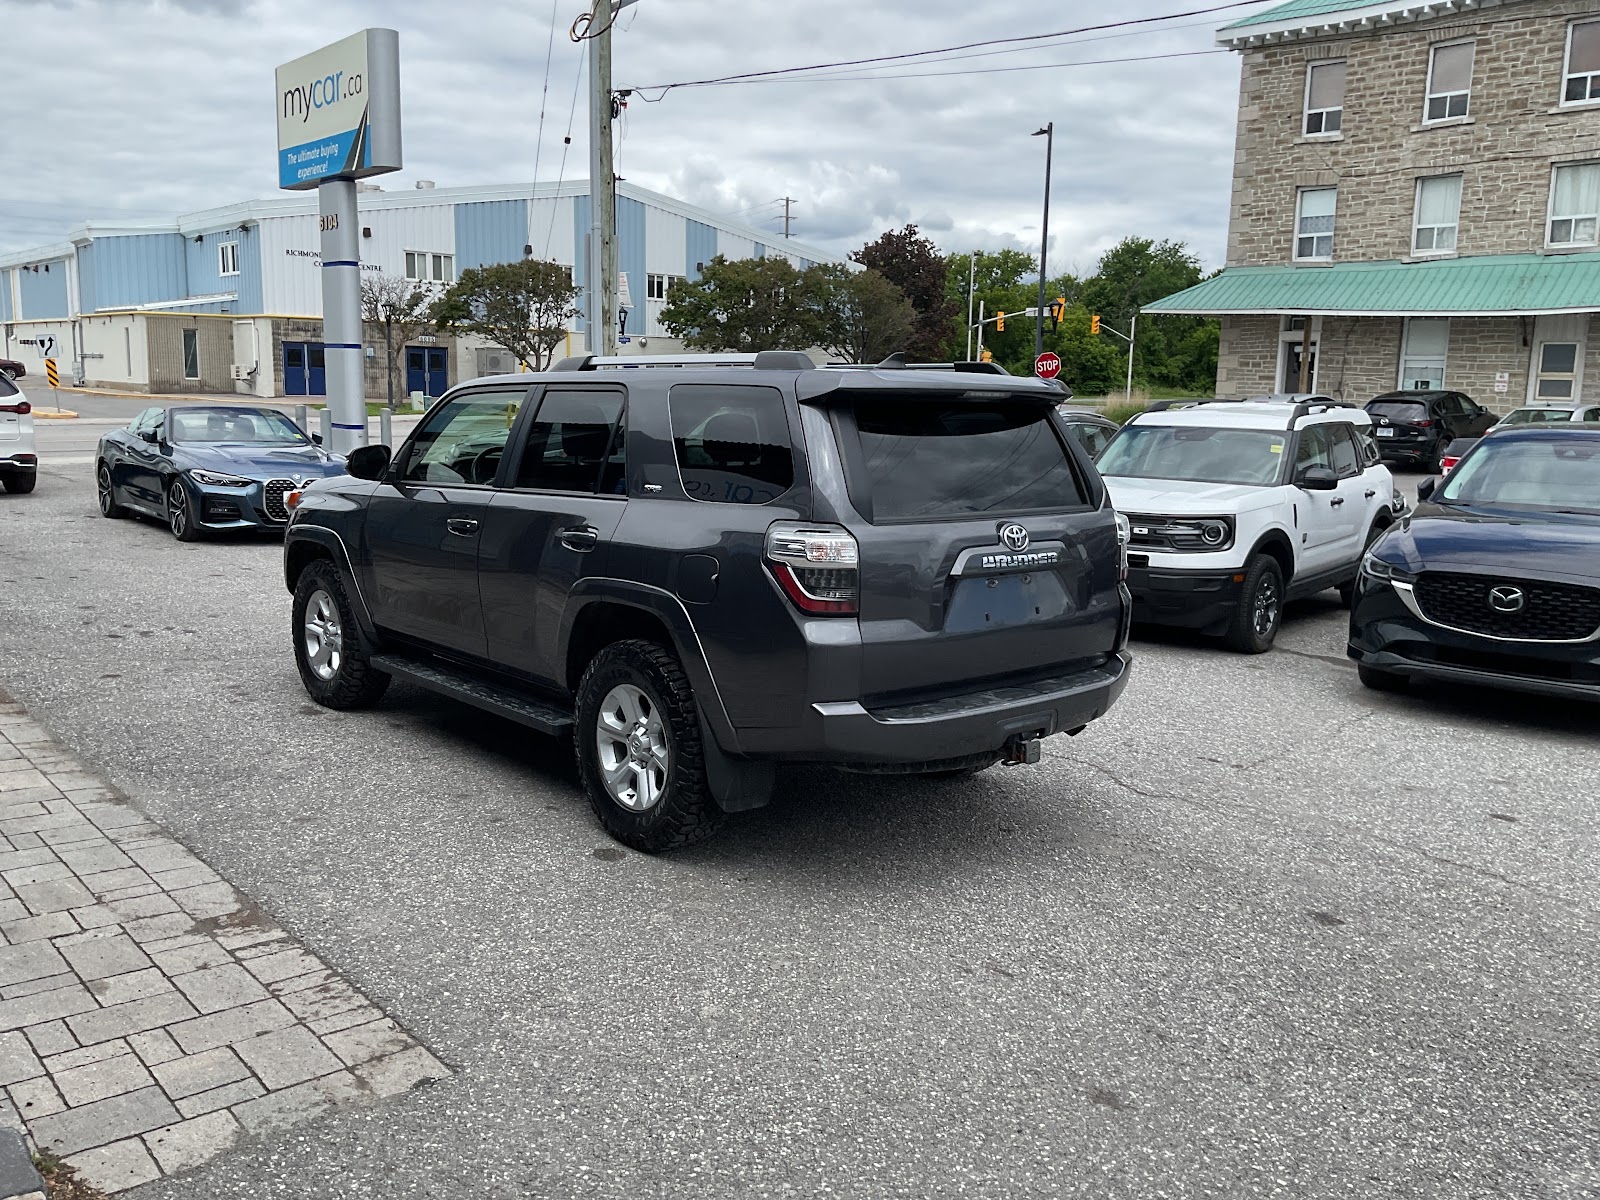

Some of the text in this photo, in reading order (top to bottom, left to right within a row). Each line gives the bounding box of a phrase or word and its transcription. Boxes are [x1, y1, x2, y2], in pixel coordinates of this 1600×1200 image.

[284, 70, 362, 123] mycar.ca
[287, 142, 339, 165] The ultimate buying
[297, 160, 329, 180] experience!
[320, 213, 339, 231] 6104
[1037, 359, 1059, 372] STOP
